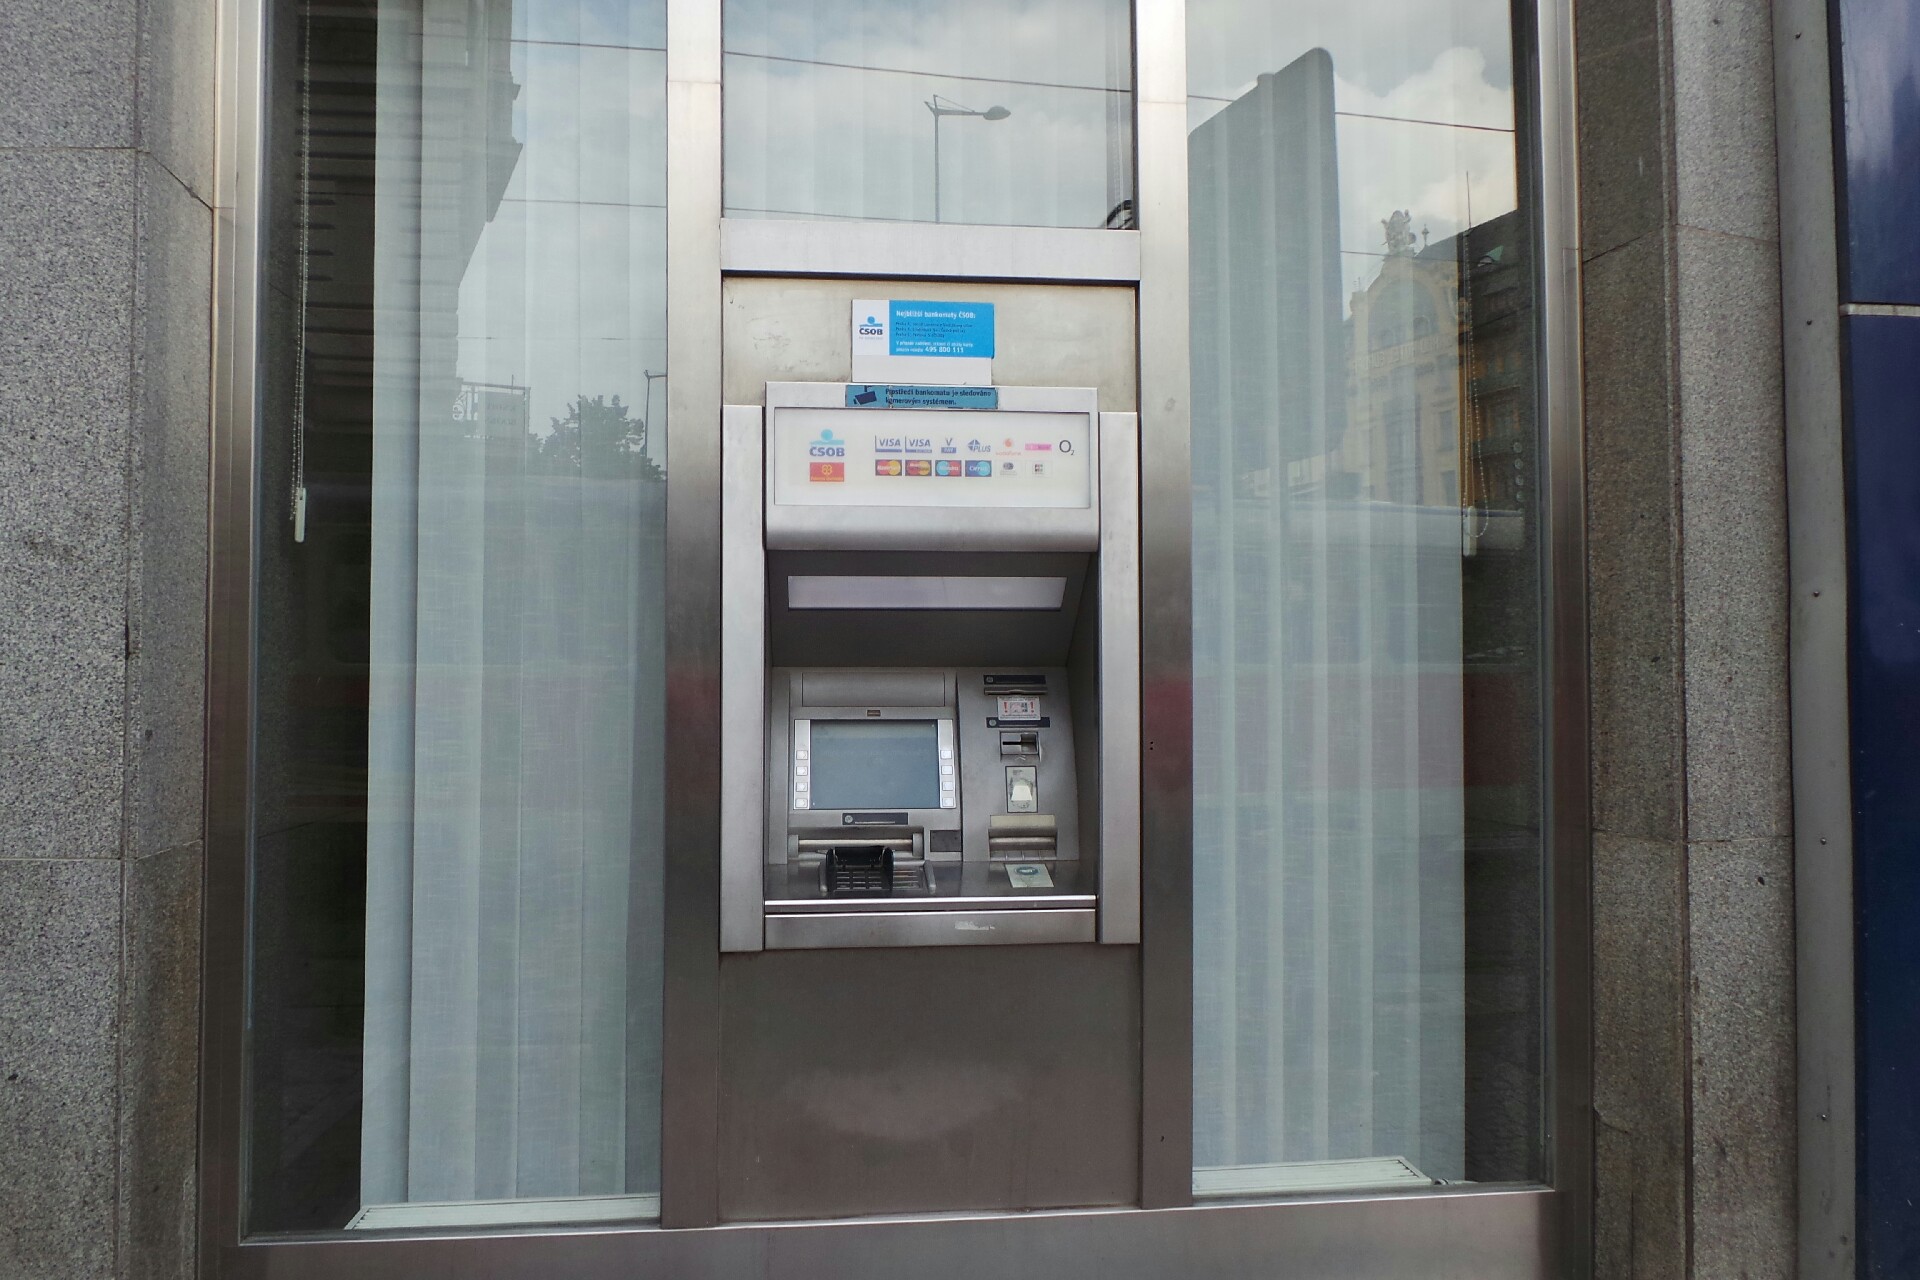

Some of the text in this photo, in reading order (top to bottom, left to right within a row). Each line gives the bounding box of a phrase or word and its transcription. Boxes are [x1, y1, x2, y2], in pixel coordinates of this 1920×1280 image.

[925, 311, 957, 320] bankomaty
[952, 389, 958, 397] je
[959, 389, 991, 397] sledováno
[922, 398, 956, 406] systémem.
[879, 438, 901, 447] VISA
[909, 438, 931, 447] VISA
[809, 446, 845, 457] ČSOB
[973, 444, 991, 453] PLUS
